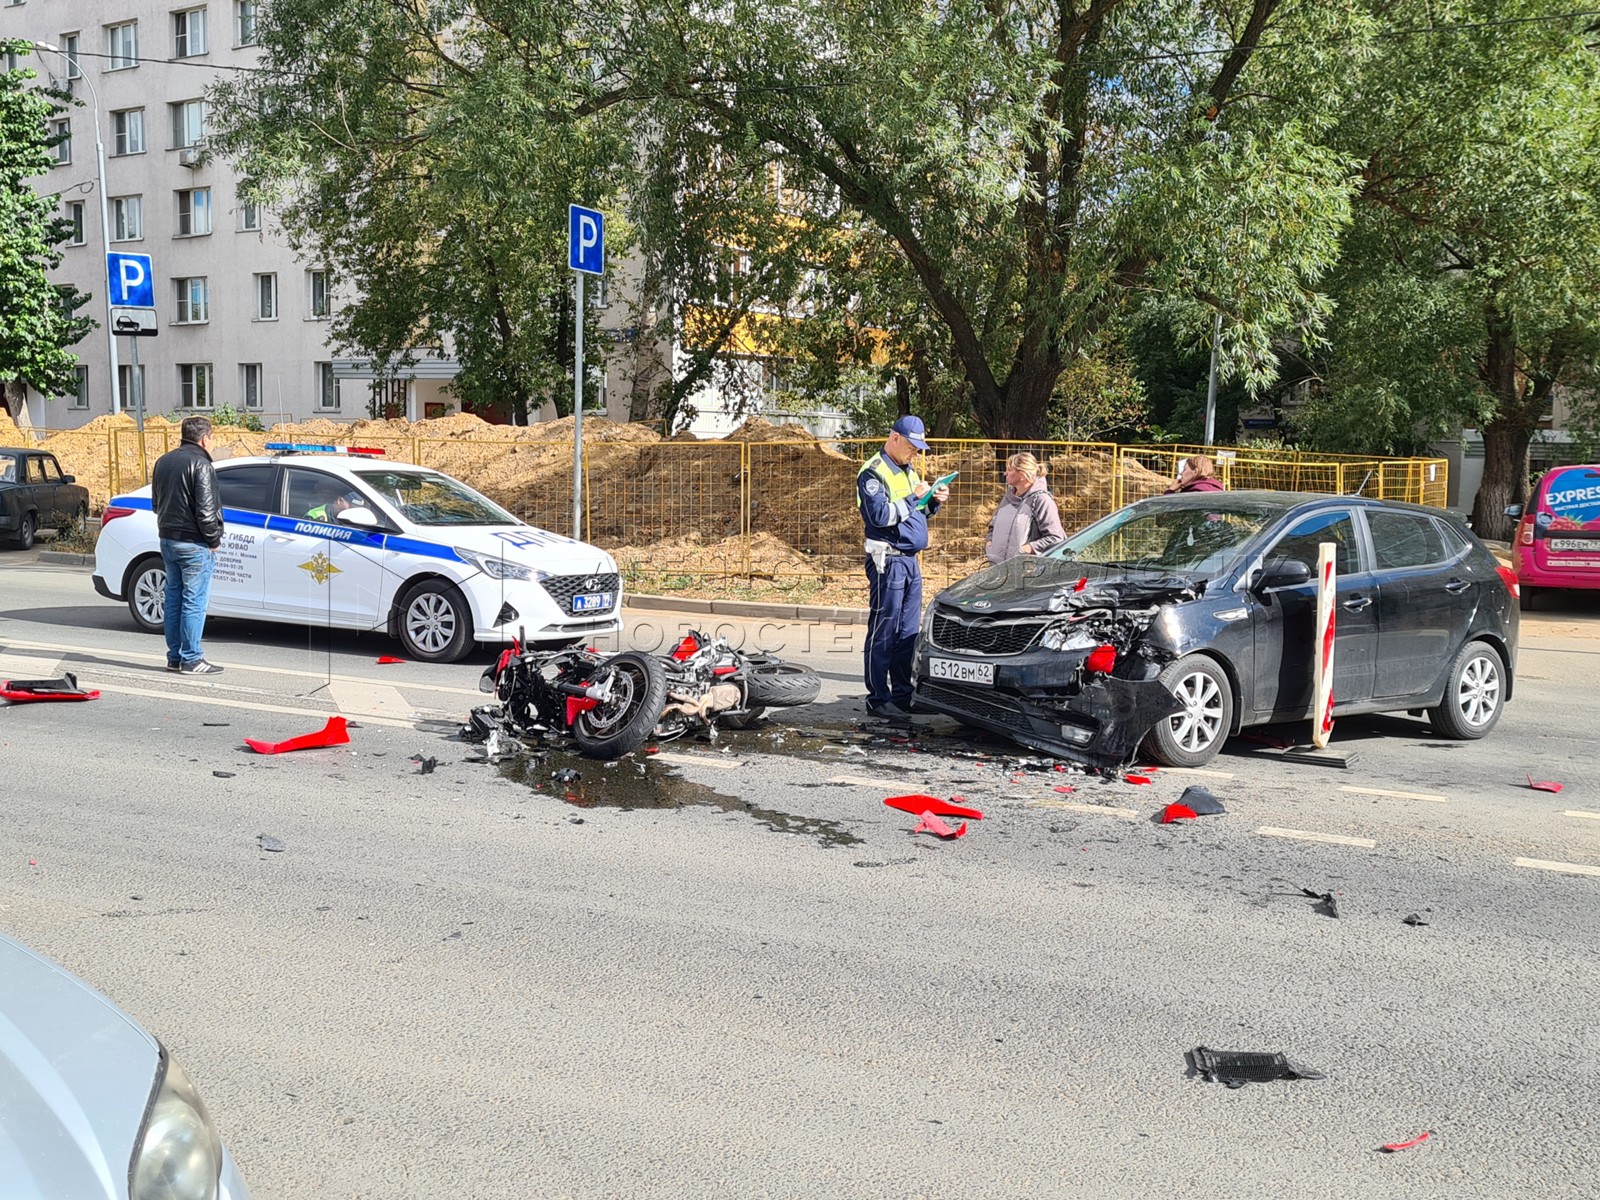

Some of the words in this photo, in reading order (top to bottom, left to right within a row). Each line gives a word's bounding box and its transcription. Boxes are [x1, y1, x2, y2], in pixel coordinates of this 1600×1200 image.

[578, 214, 598, 264] P
[119, 258, 145, 304] P
[229, 532, 256, 544] ГИБДД
[294, 520, 353, 541] ПОЛИЦИЯ
[228, 542, 249, 552] ЮВАО
[933, 662, 975, 680] С512ВМ
[977, 664, 990, 678] 62
